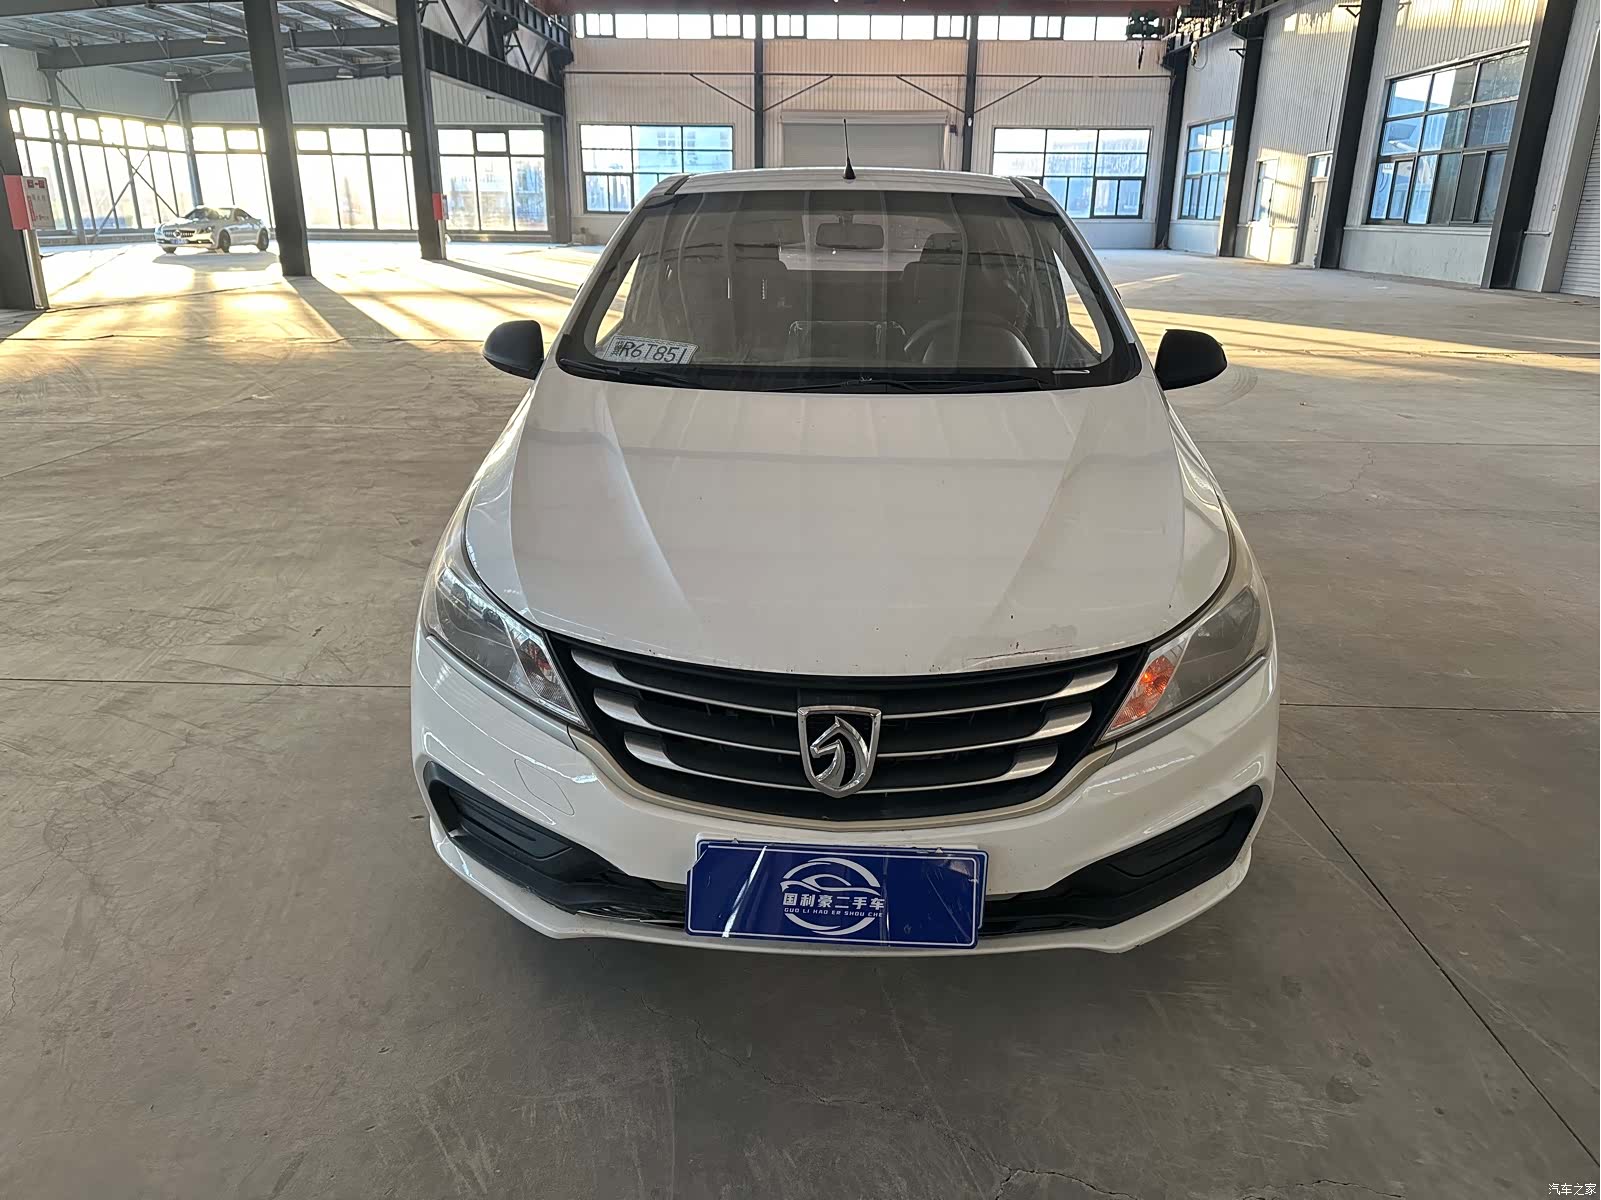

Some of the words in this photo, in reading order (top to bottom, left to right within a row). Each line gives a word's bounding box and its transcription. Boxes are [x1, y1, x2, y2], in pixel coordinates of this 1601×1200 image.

[783, 893, 885, 910] 国利豪二手车
